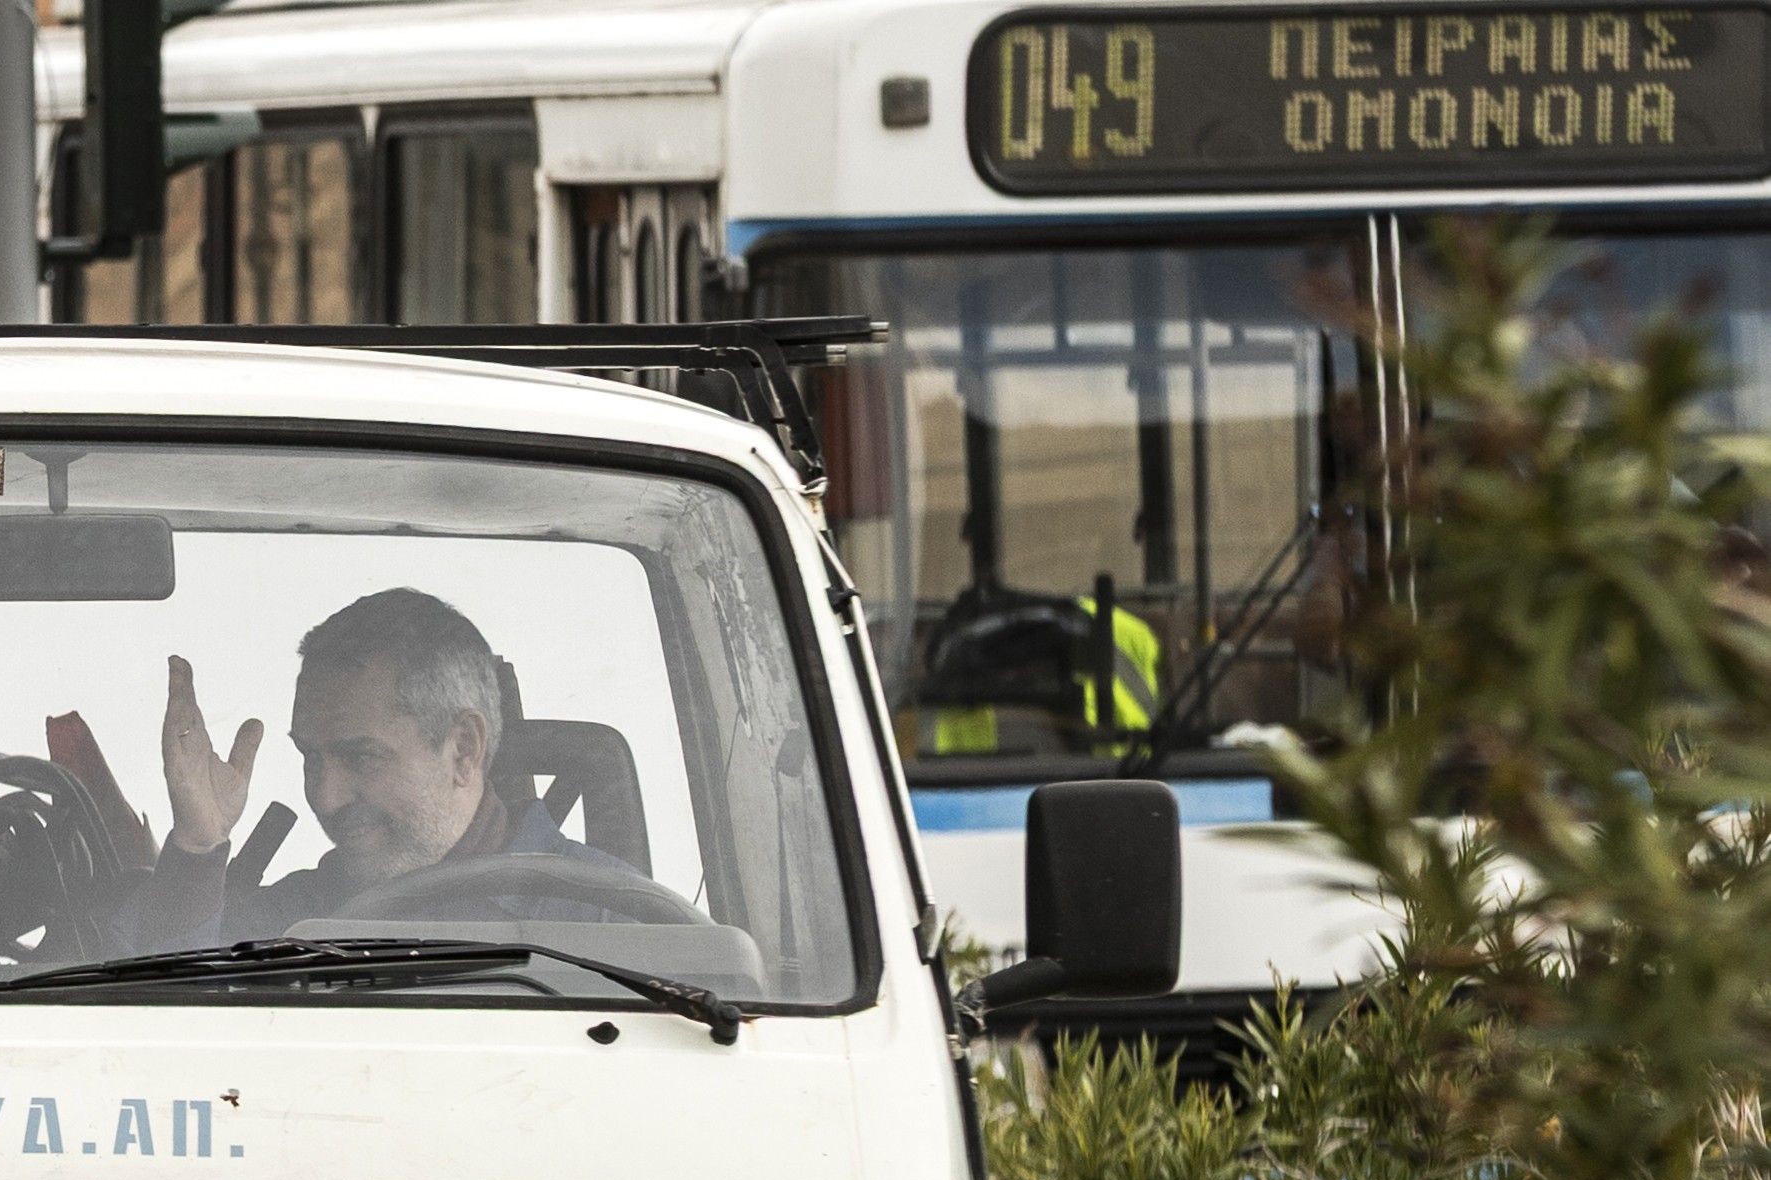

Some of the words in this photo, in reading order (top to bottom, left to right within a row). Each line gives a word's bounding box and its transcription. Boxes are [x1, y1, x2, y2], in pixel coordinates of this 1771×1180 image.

[1269, 10, 1693, 80] ΠΕΙΡΑΙΑΣ
[999, 24, 1156, 161] 049
[1283, 82, 1677, 153] ΟΜΟΝΟΙΑ
